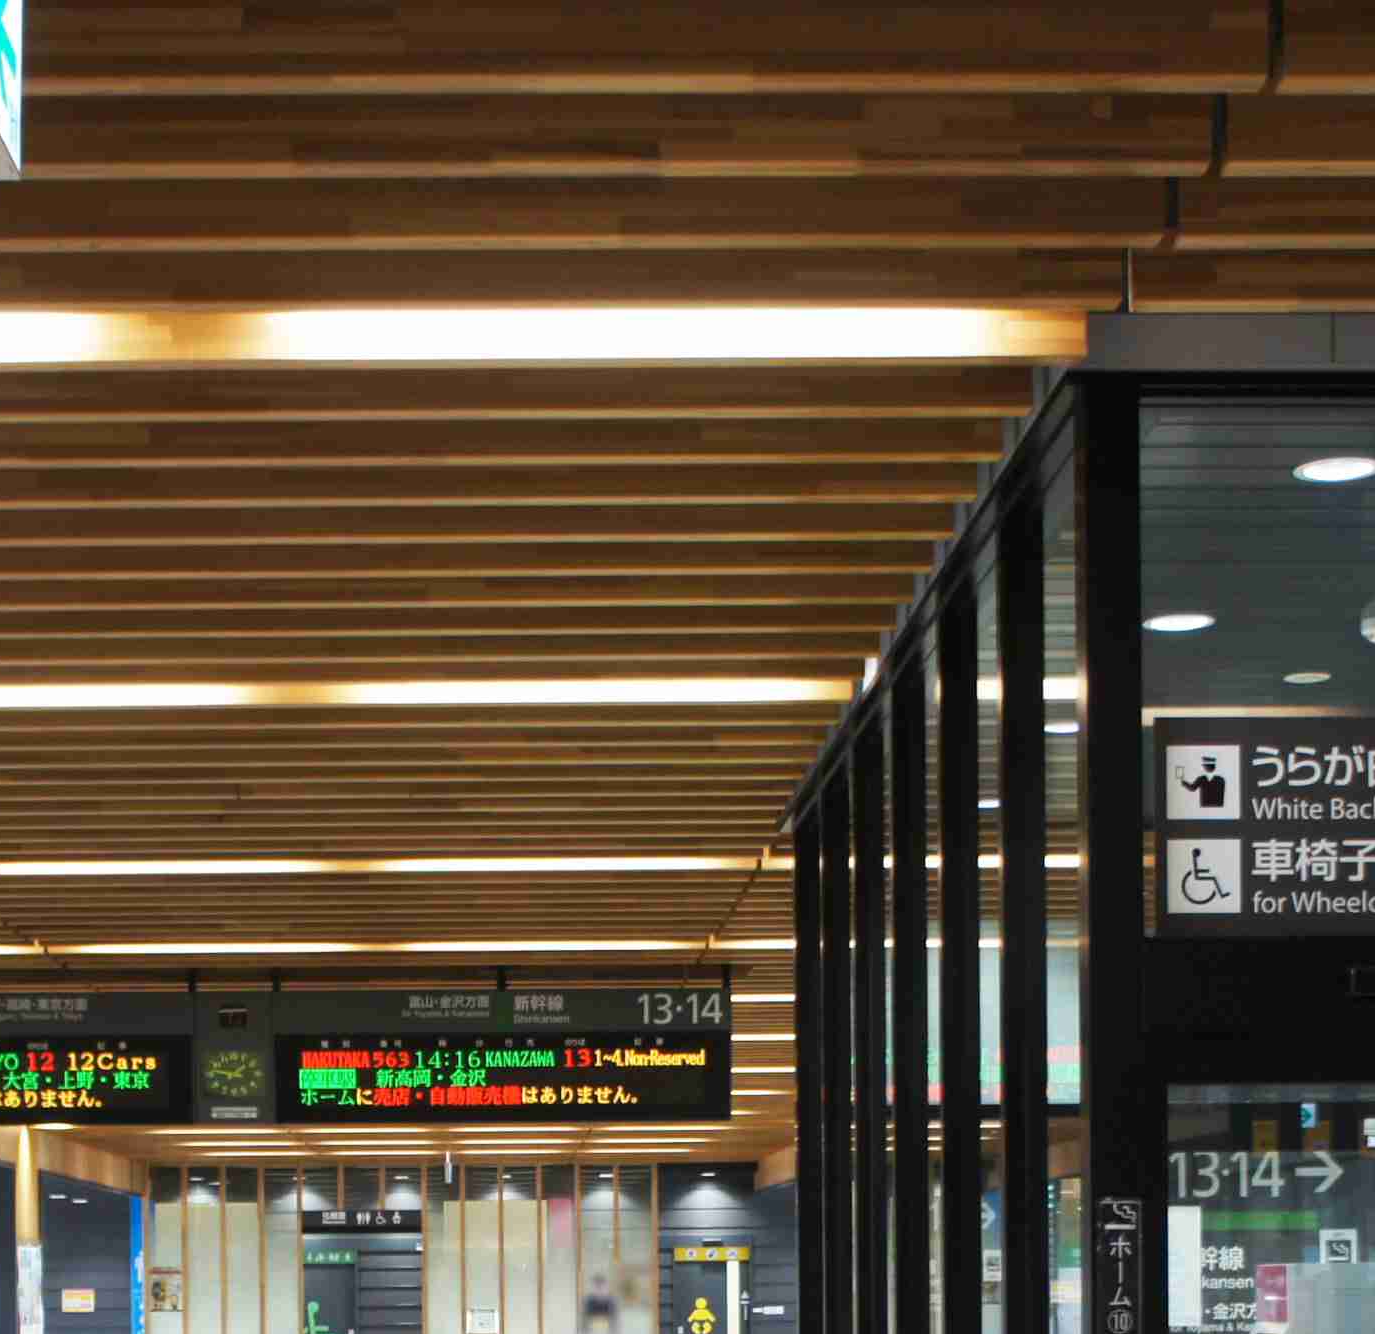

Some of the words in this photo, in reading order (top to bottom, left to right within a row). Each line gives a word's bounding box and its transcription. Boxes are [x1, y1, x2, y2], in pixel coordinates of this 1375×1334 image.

[1252, 797, 1323, 821] White
[1252, 891, 1287, 915] for
[27, 1053, 55, 1072] 12
[371, 1051, 411, 1069] 563
[415, 1051, 481, 1069] 14:16
[485, 1051, 555, 1068] KANAZAWA
[564, 1050, 593, 1068] 13
[1200, 1246, 1244, 1271] 幹線
[1201, 1276, 1255, 1289] kansen
